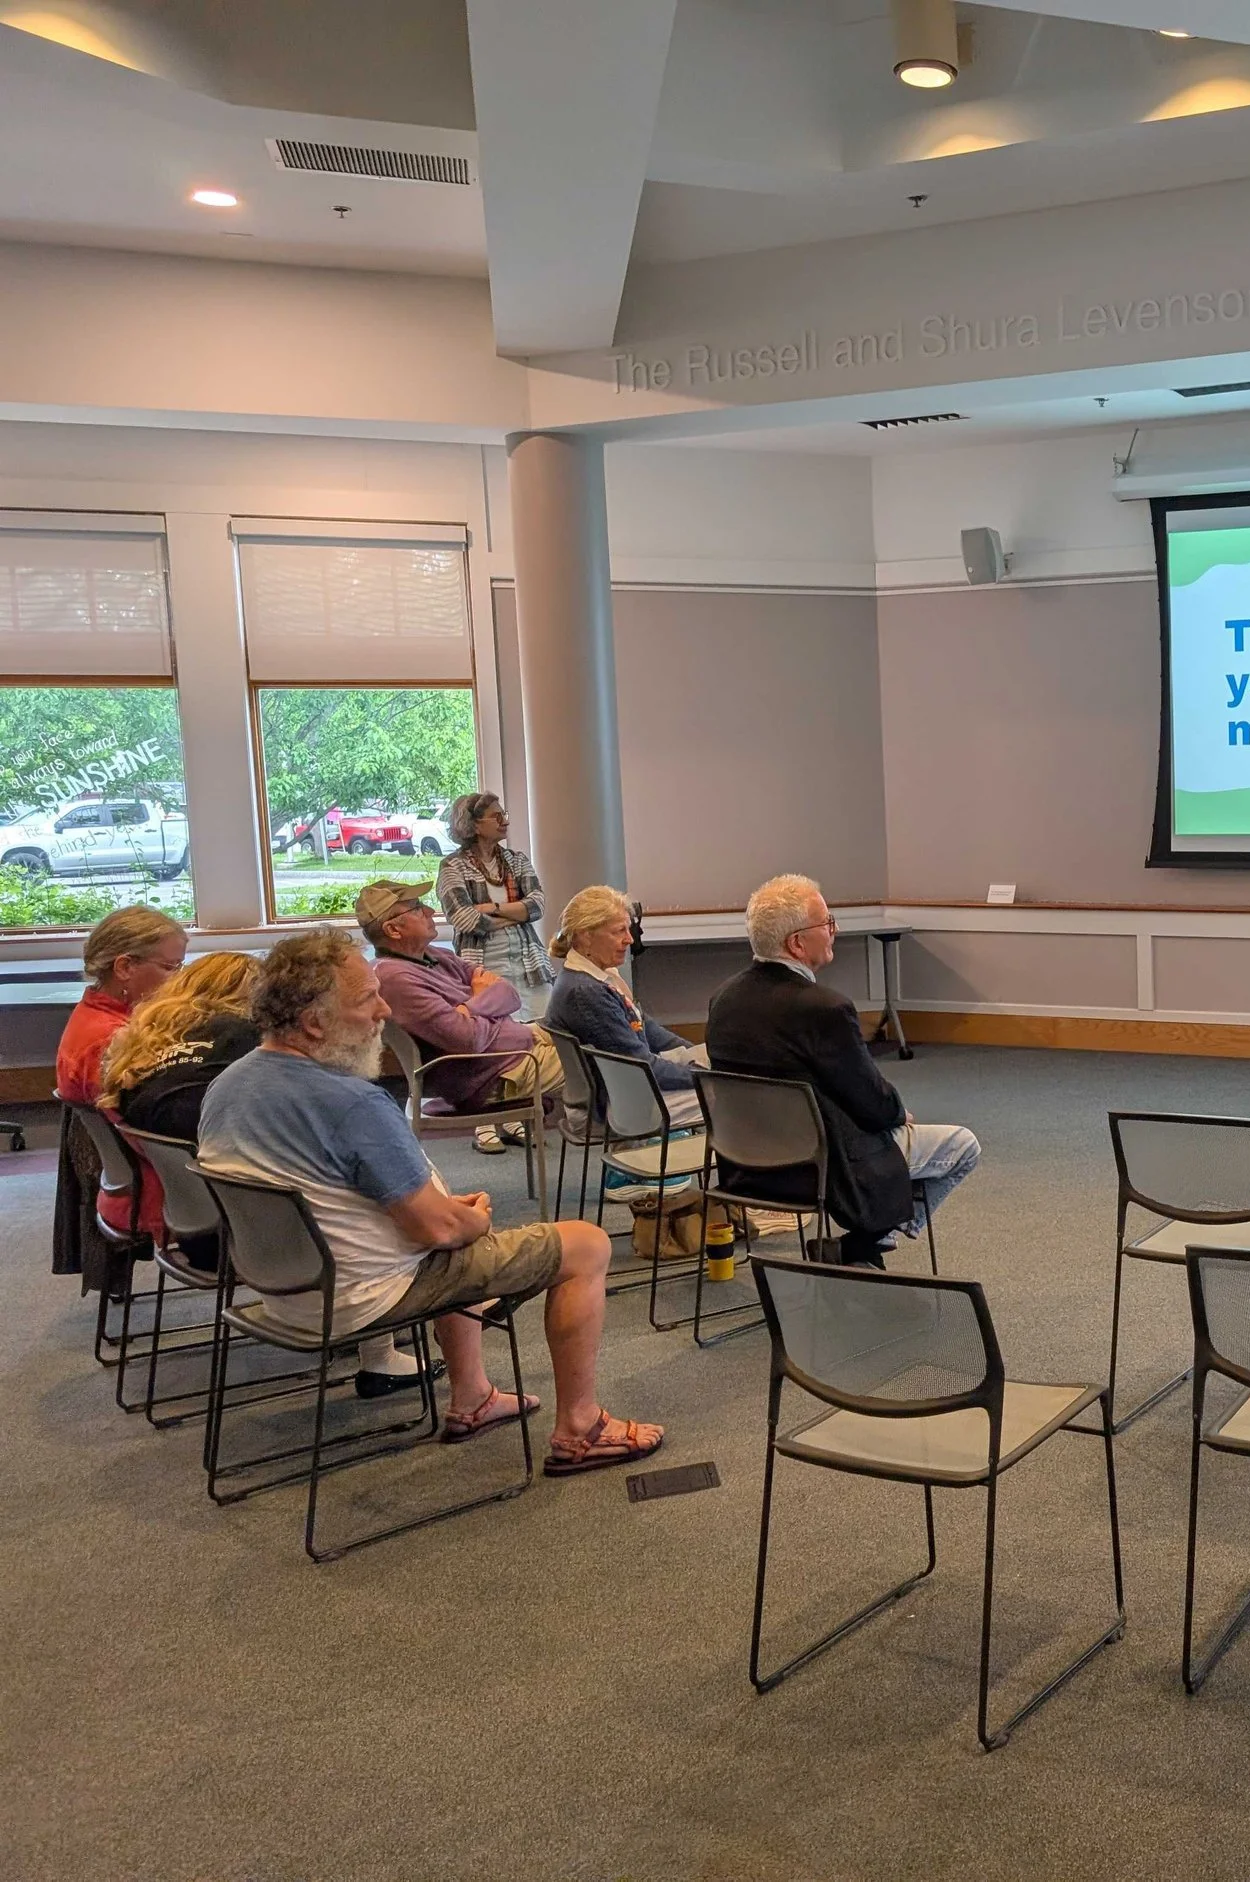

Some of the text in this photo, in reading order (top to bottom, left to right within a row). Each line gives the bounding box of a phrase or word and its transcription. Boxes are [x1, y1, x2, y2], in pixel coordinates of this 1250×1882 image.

[609, 353, 671, 395] The
[687, 330, 819, 386] Russell
[832, 320, 904, 367] and
[919, 312, 1041, 360] Shura
[11, 730, 119, 789] always toward
[35, 737, 167, 808] SUNSHINE
[39, 731, 74, 751] face
